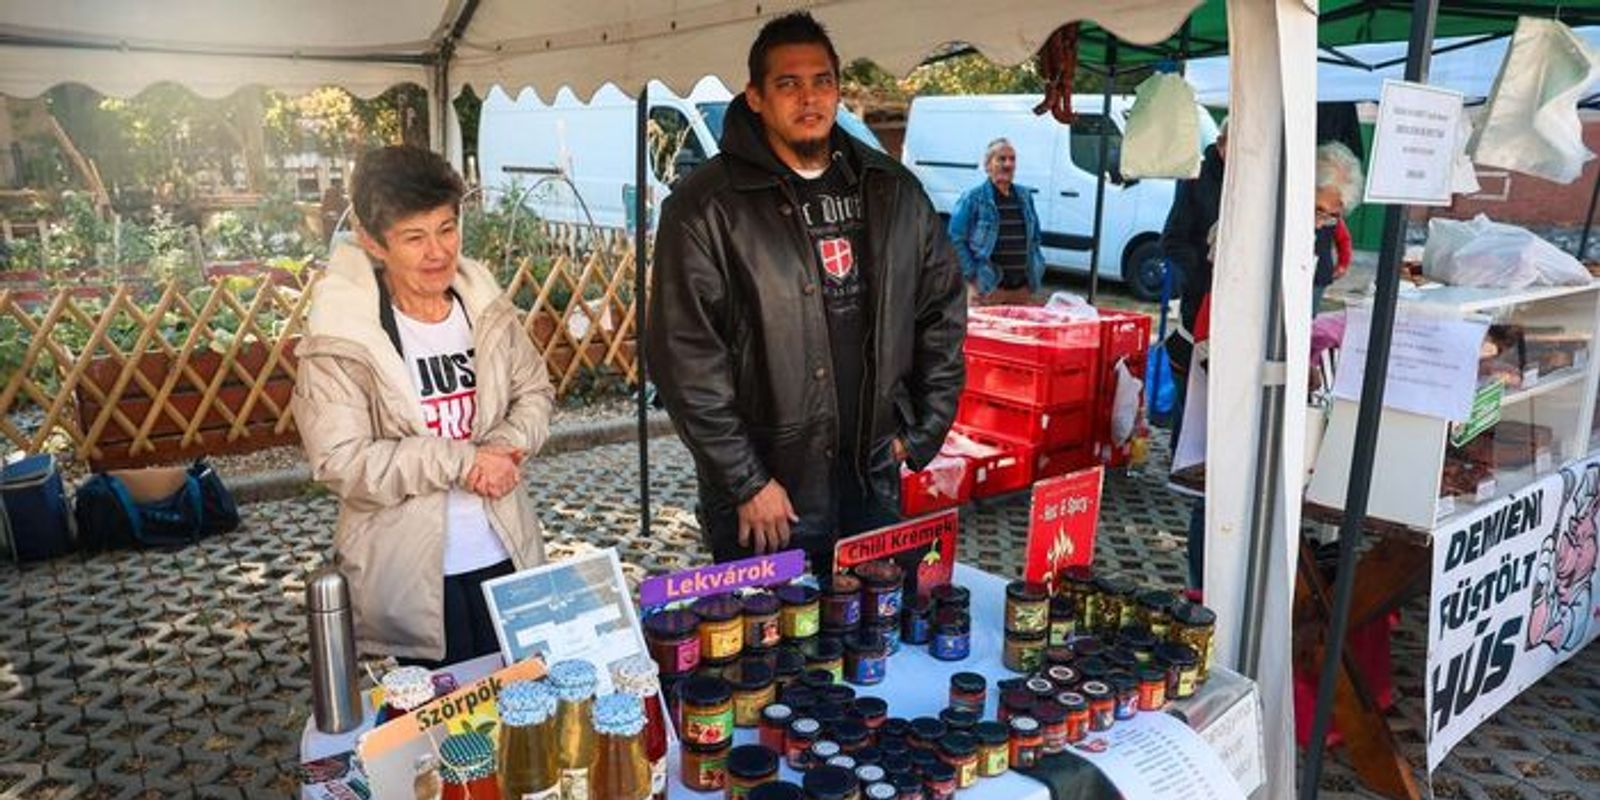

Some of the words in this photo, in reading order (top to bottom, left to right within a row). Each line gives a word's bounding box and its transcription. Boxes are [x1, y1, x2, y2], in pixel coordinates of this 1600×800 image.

[847, 534, 886, 560] Chili
[666, 559, 777, 598] Lekvárok
[1440, 551, 1537, 640] FÜSTÖLT
[1430, 616, 1523, 735] HÚS
[415, 676, 503, 732] Szörpök
